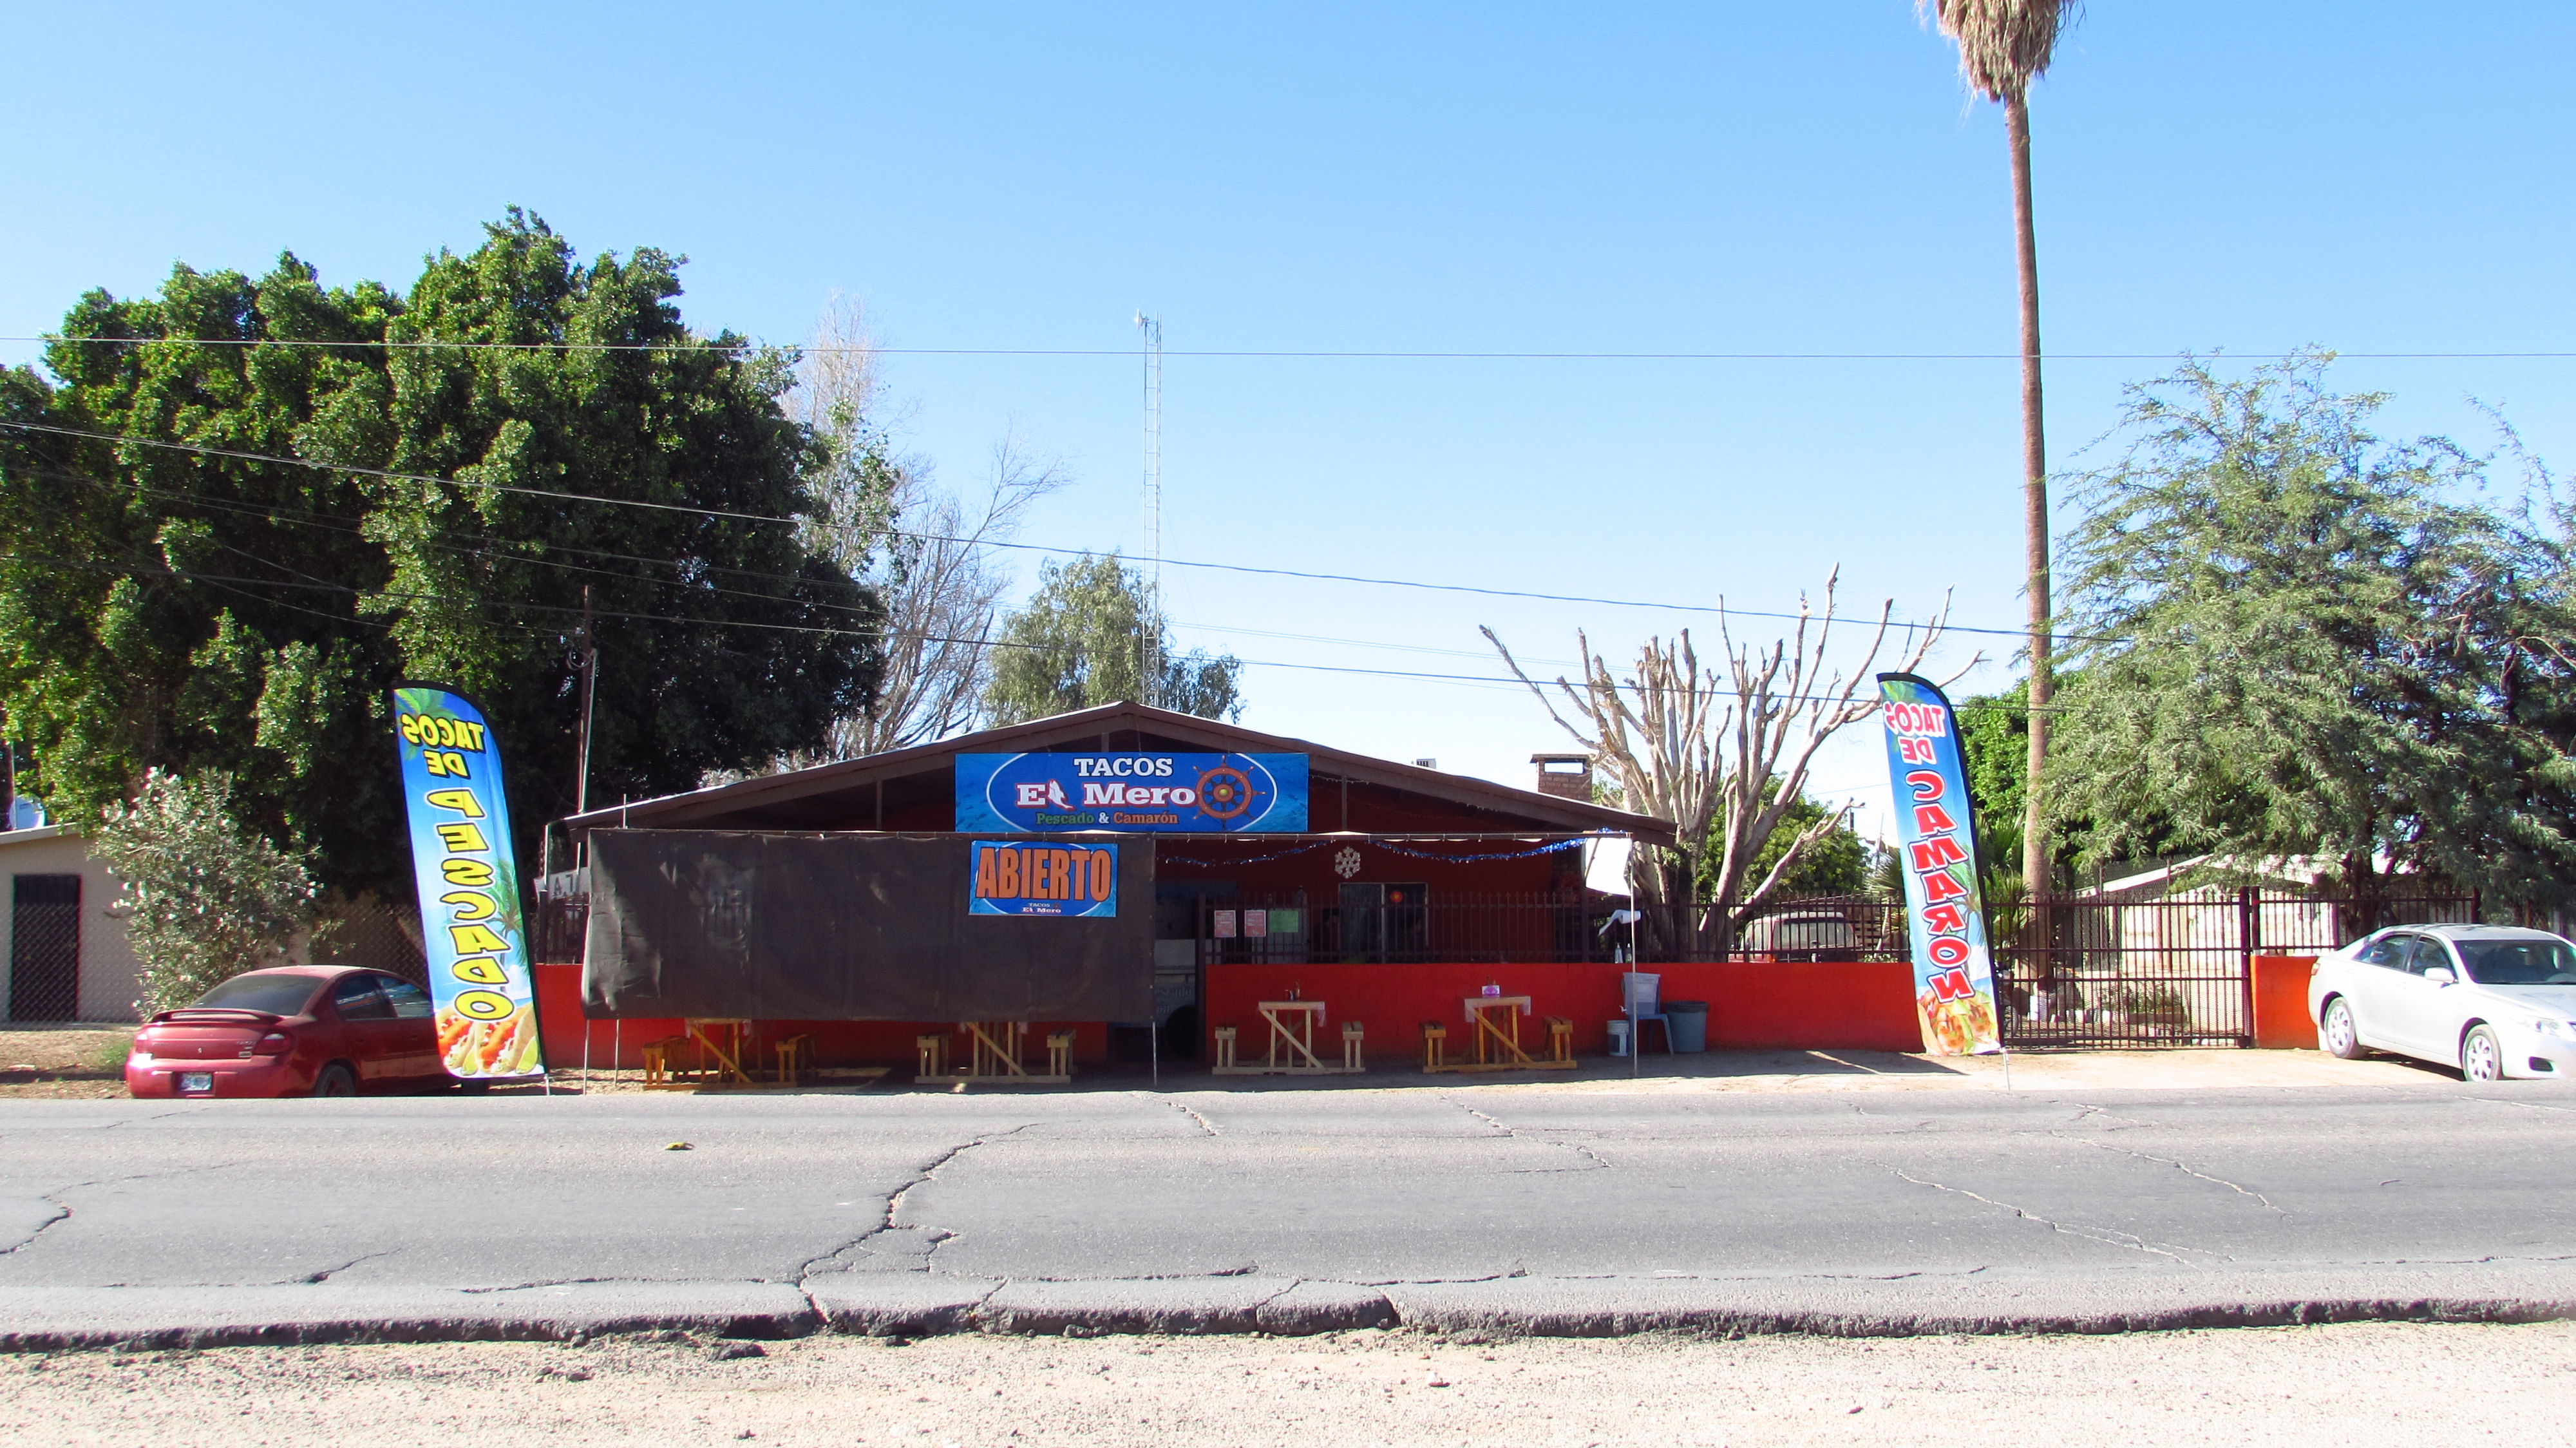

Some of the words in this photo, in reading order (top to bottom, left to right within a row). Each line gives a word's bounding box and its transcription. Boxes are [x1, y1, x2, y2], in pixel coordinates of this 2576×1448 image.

[1073, 757, 1173, 777] TACOS
[1083, 783, 1197, 807] Mero
[1036, 812, 1094, 824] Pescado
[1098, 812, 1109, 824] &
[1113, 811, 1178, 824] Camarón
[976, 847, 1112, 902] ABIERTO
